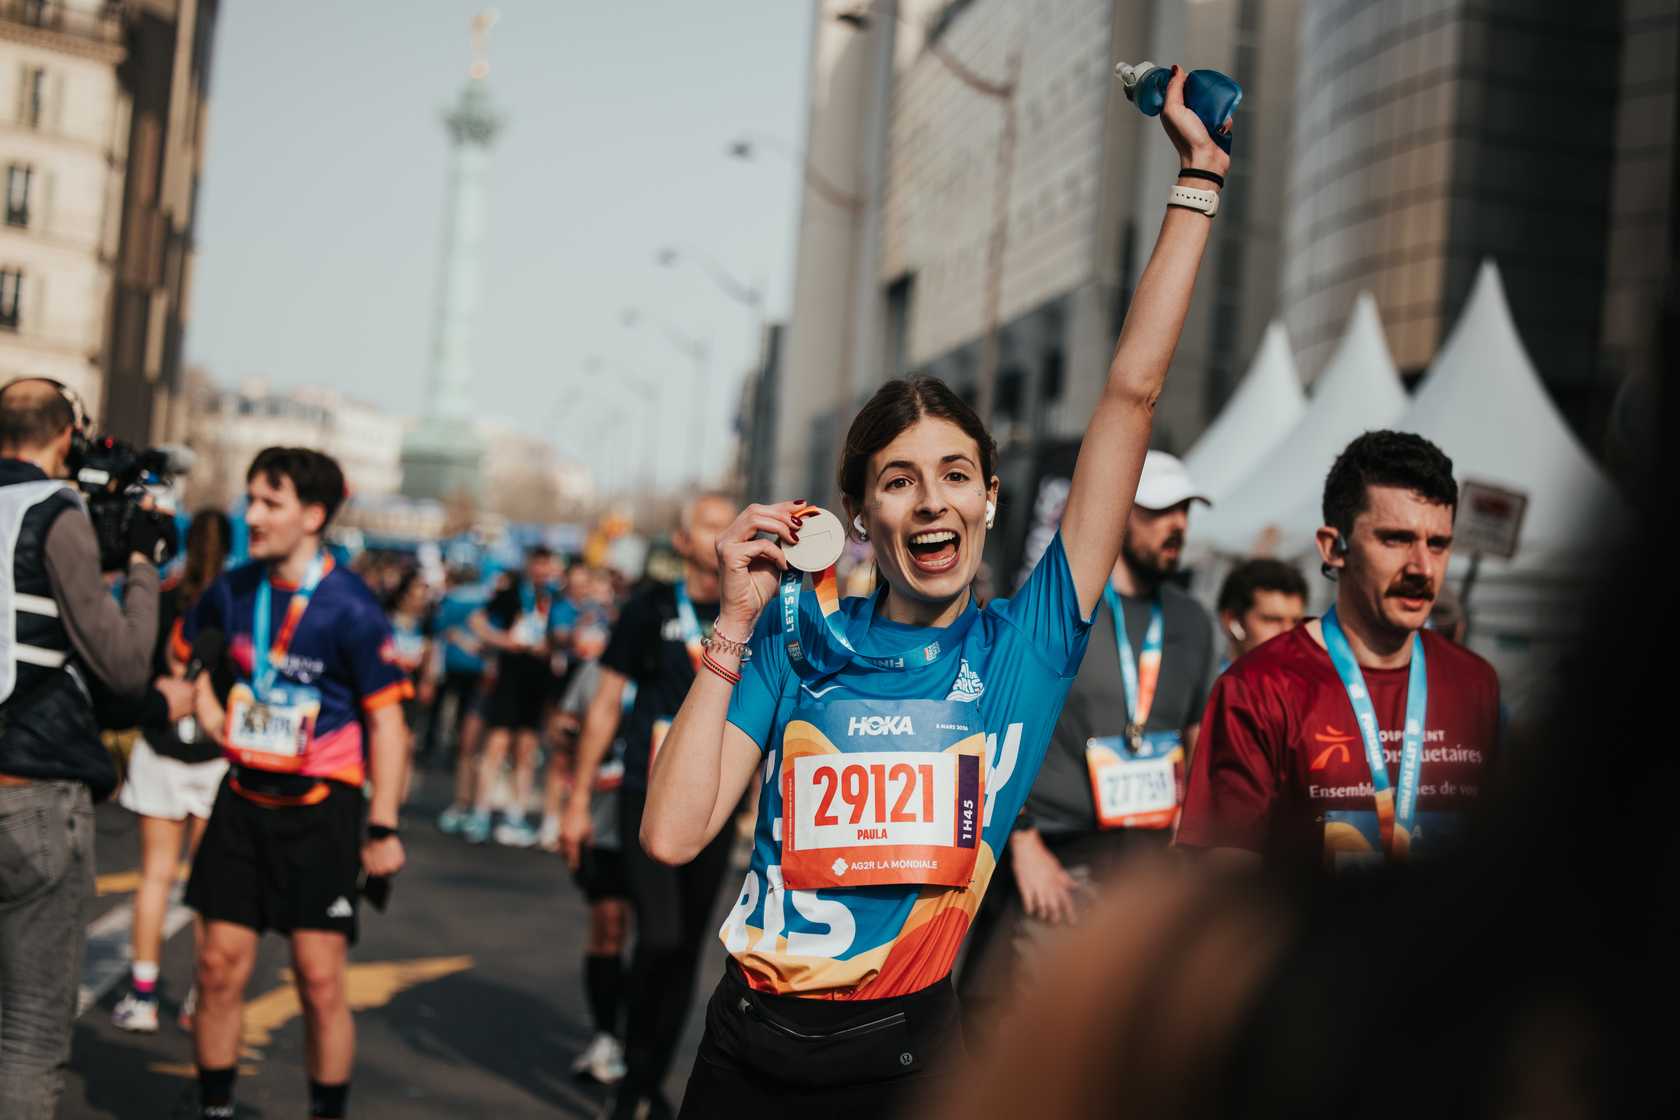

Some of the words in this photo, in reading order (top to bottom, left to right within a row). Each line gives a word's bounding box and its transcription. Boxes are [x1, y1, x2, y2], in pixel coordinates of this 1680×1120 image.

[848, 716, 914, 736] HOKA
[812, 763, 934, 826] 29121
[857, 829, 888, 840] PAULA
[851, 861, 876, 871] AG2R
[877, 860, 890, 870] LA
[891, 859, 938, 870] MONDIALE
